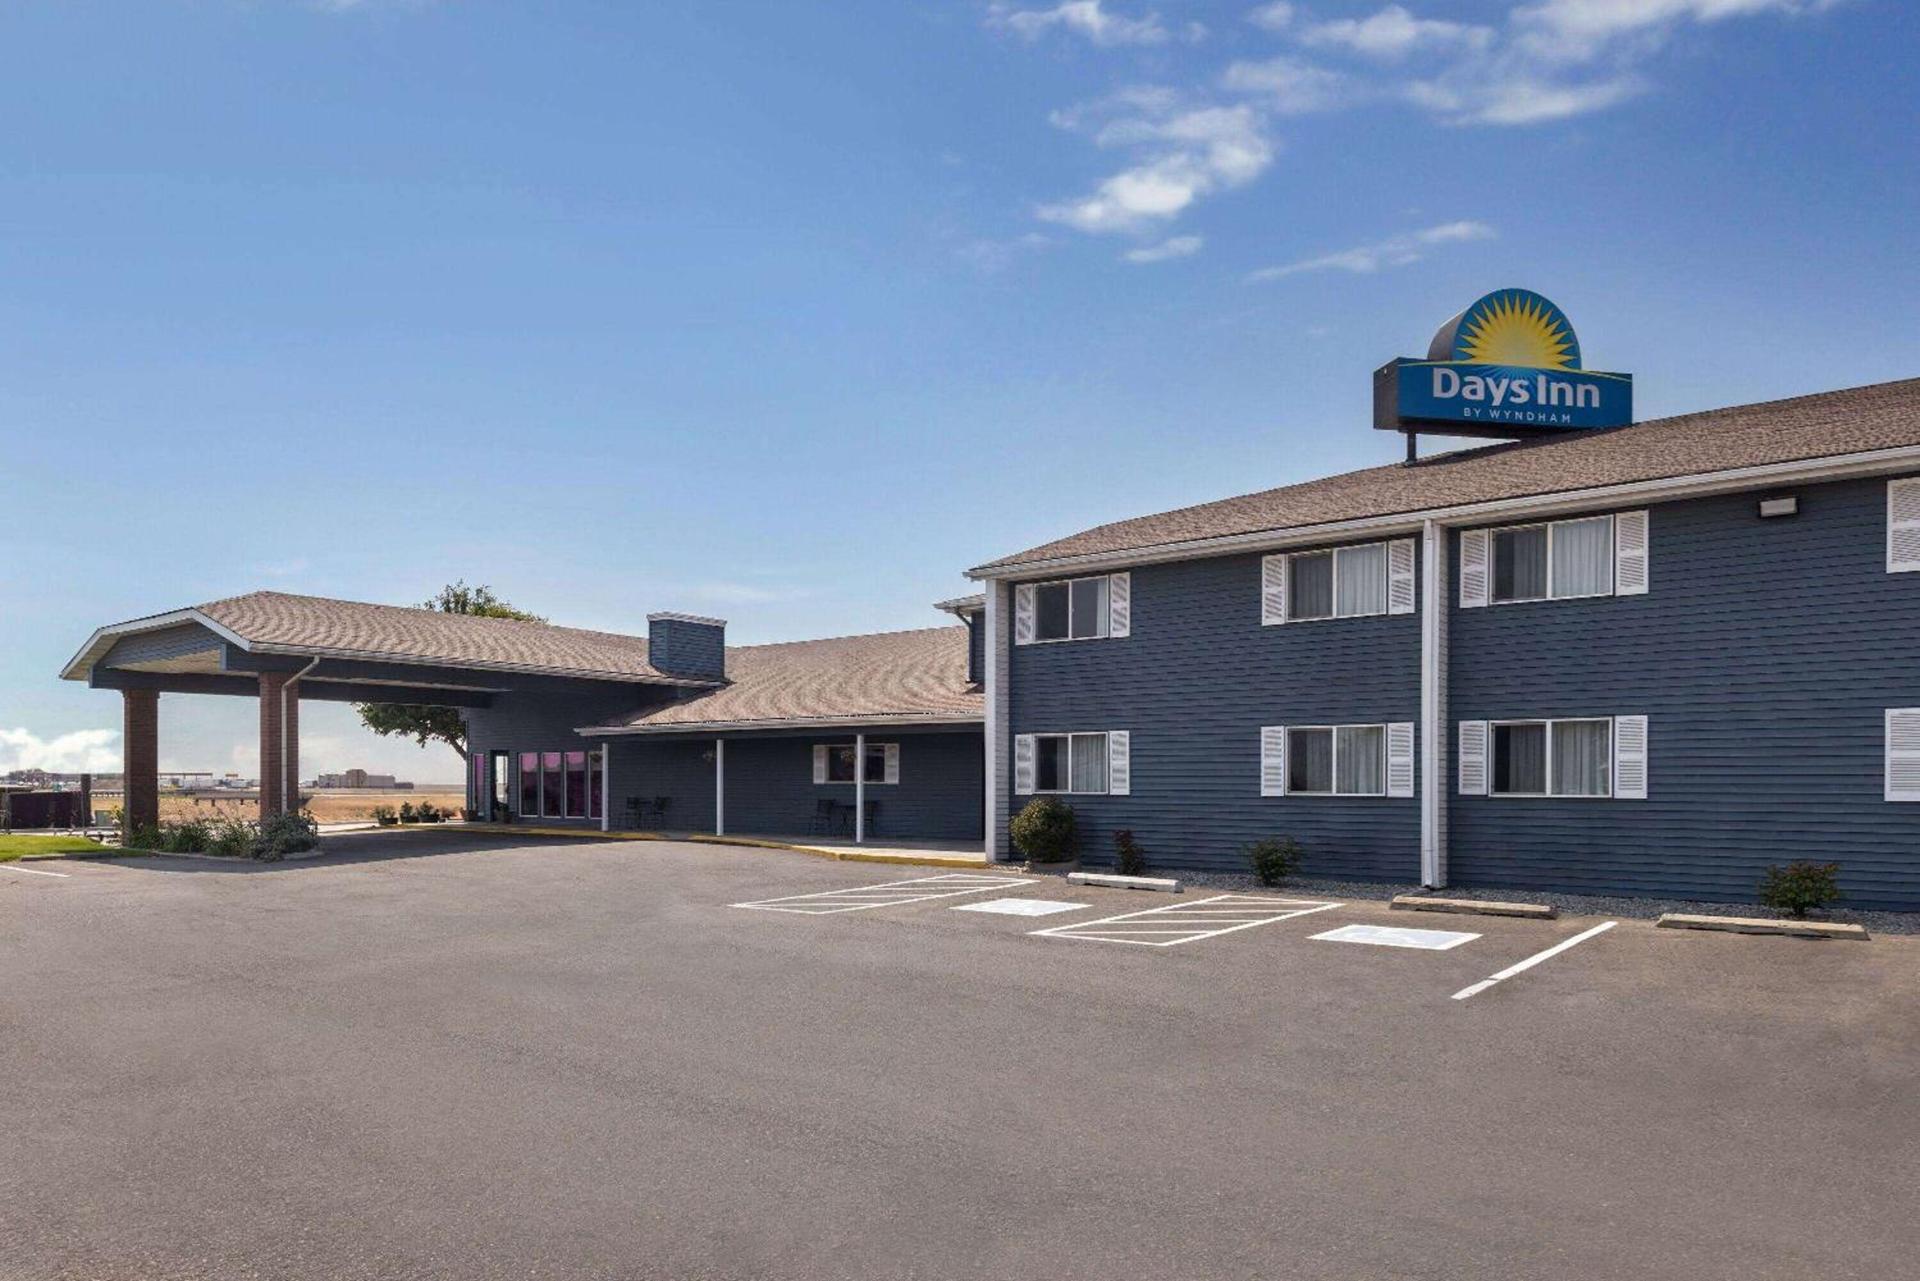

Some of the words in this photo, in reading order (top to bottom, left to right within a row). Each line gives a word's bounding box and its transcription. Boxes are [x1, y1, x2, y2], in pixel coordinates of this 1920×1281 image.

[1432, 367, 1530, 406] Days
[1537, 375, 1600, 408] Inn
[1463, 407, 1481, 418] BY
[1489, 409, 1571, 424] WYNDHAM
